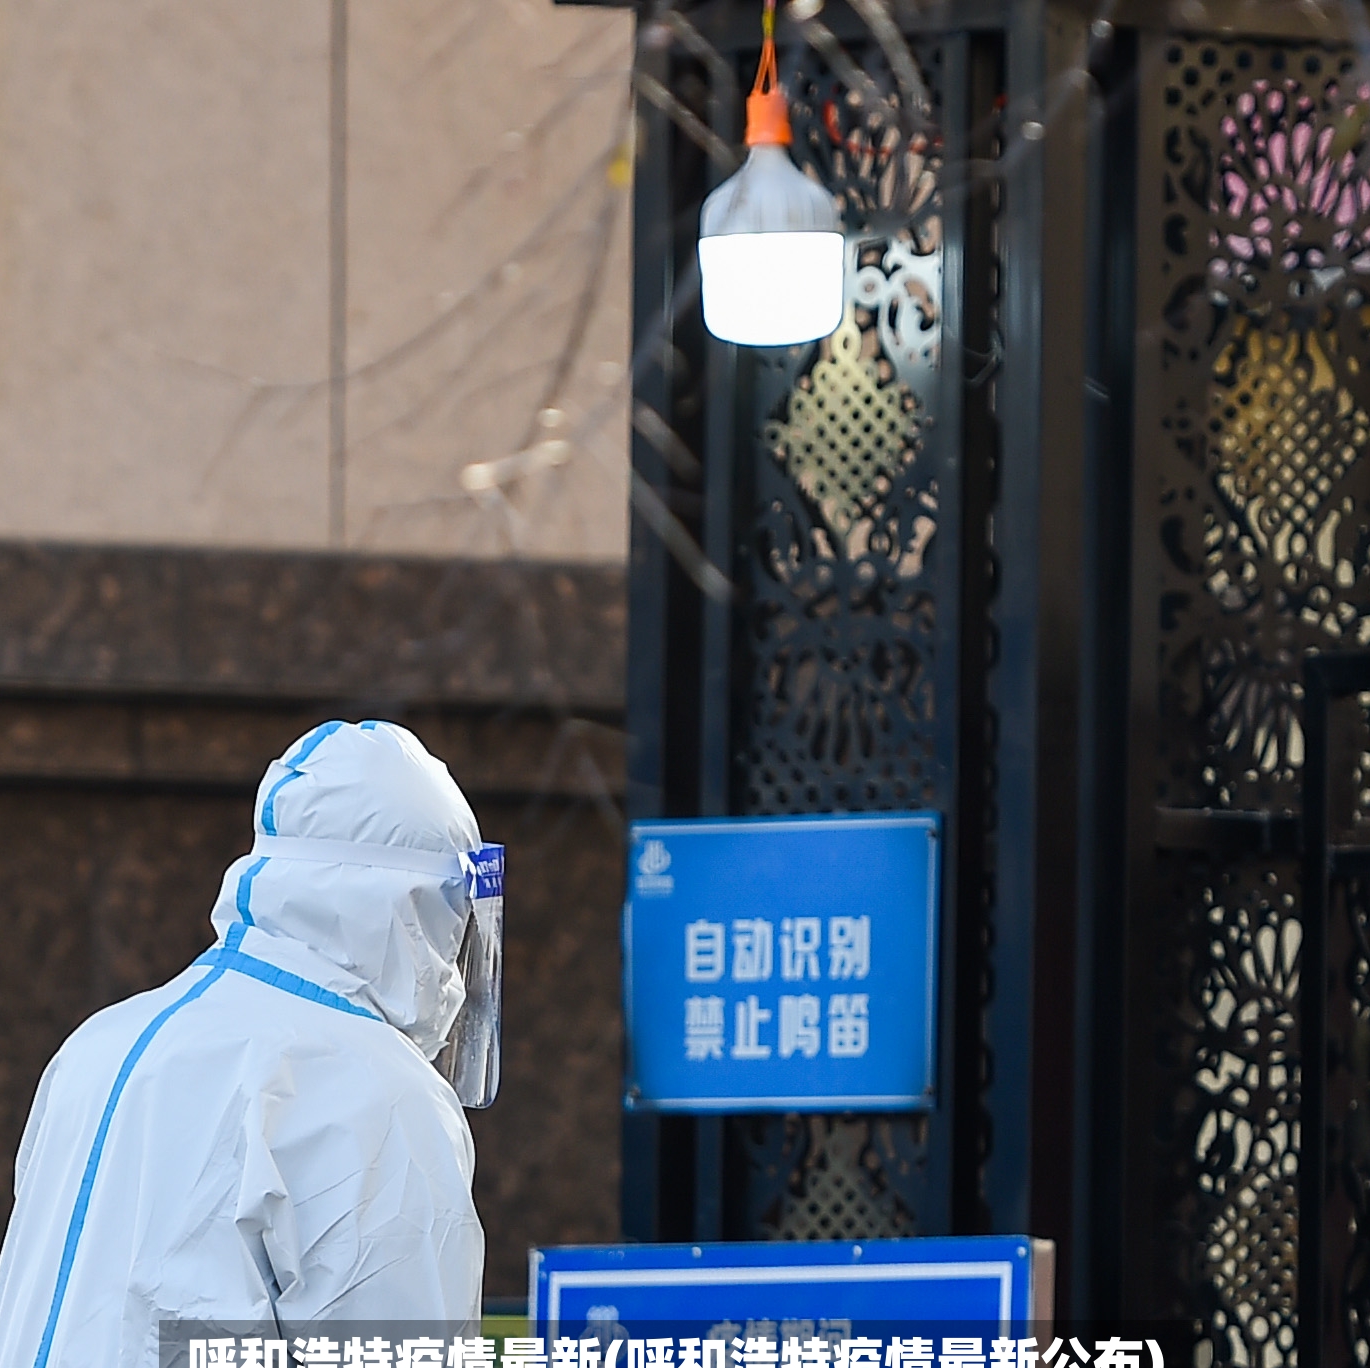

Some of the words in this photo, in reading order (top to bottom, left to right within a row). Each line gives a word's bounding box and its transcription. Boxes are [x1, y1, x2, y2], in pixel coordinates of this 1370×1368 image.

[683, 914, 871, 983] 自动识别
[683, 992, 870, 1061] 禁止鸣笛
